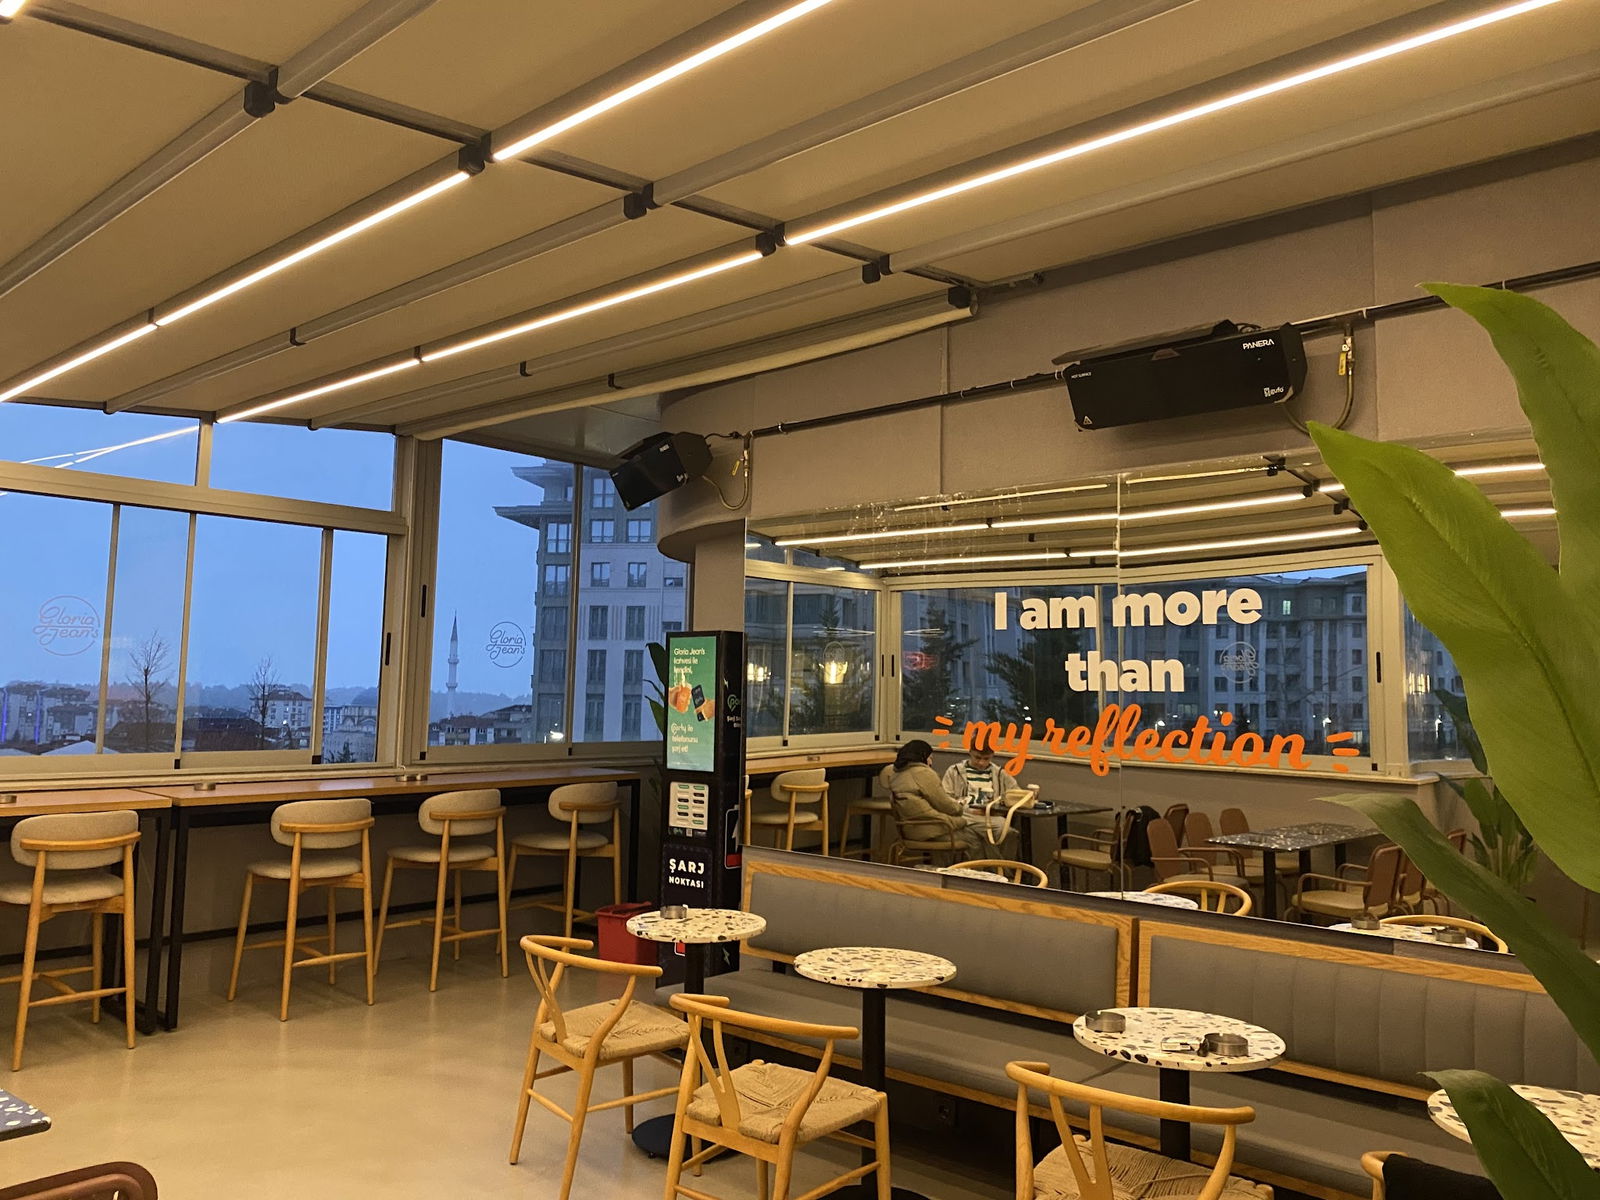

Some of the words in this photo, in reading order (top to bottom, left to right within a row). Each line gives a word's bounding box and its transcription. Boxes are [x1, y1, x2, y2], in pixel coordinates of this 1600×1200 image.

[1242, 338, 1275, 350] PANERA
[994, 592, 1008, 631] I
[1019, 595, 1098, 631] am
[1111, 587, 1264, 628] more
[33, 606, 96, 635] Gloria
[40, 627, 99, 646] Jean's
[486, 629, 523, 651] Gloria
[490, 645, 526, 660] Jean's
[1064, 650, 1185, 693] than
[962, 720, 1034, 777] my
[1041, 703, 1311, 777] reflection
[669, 858, 705, 875] ŞARJ
[668, 876, 704, 889] NOKTASI
